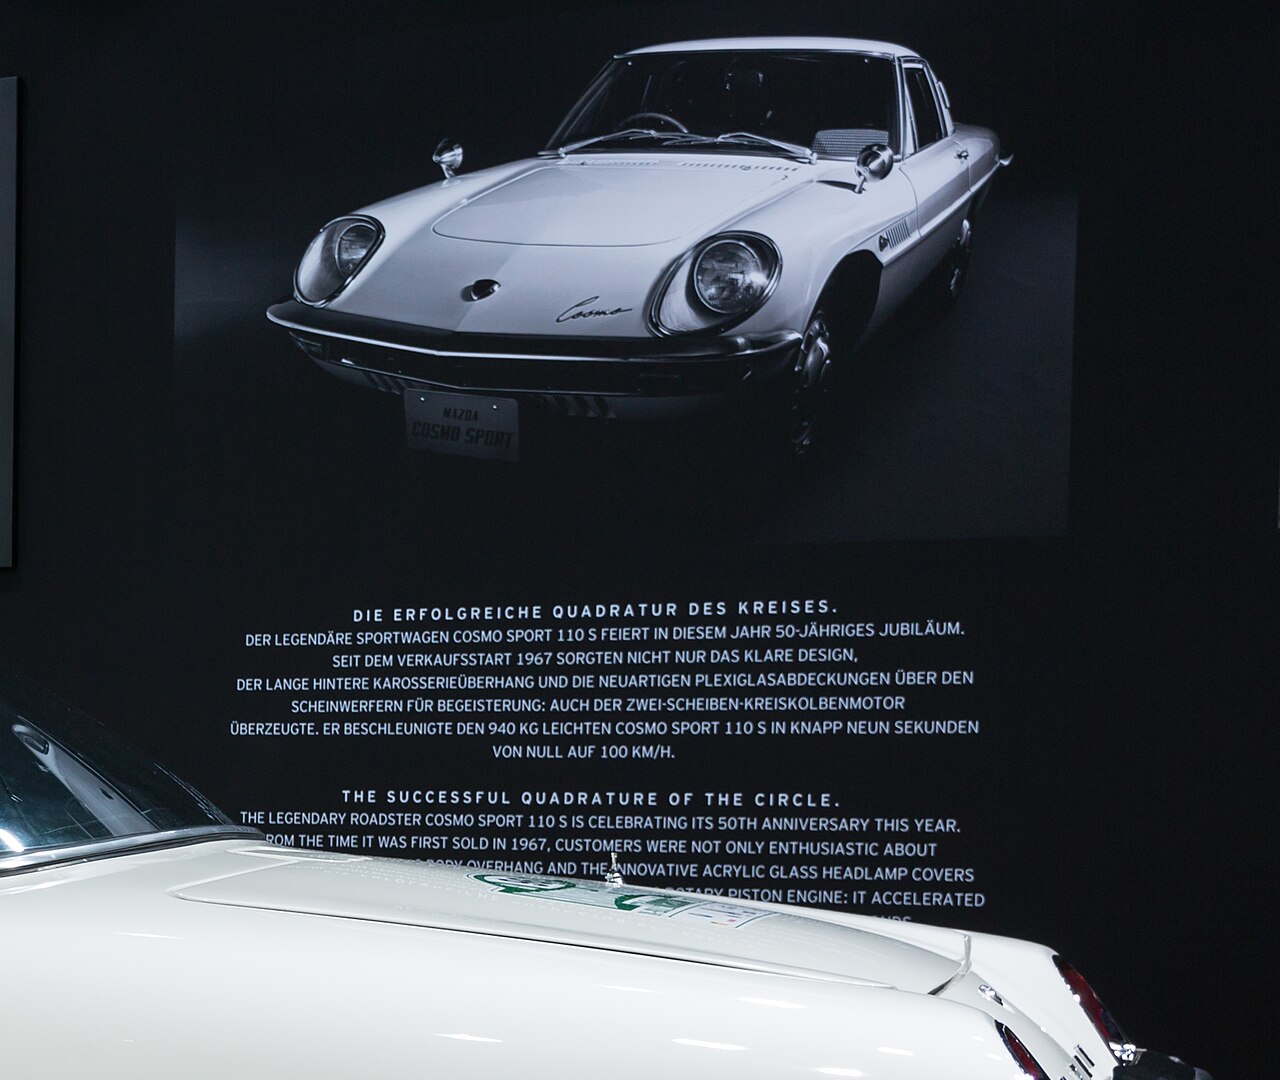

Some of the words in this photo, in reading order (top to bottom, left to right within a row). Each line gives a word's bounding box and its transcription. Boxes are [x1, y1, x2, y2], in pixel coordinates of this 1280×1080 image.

[411, 421, 462, 442] COSMO
[464, 427, 515, 449] SPORT
[353, 608, 383, 623] DIE
[393, 605, 542, 622] ERFOLGREICHE
[552, 602, 677, 619] QUADRATUR
[688, 601, 727, 616] DES
[738, 599, 837, 615] KREISES.
[245, 633, 272, 647] DER
[274, 630, 353, 647] LEGENDÄRE
[356, 630, 450, 645] SPORTWAGEN
[452, 629, 503, 644] COSMO
[506, 628, 553, 643] SPORT
[557, 628, 585, 642] 110
[601, 627, 650, 641] FEIERT
[654, 627, 669, 641] IN
[672, 625, 727, 640] DIESEM
[730, 625, 772, 640] JAHR
[775, 621, 875, 639] 50-JÄHRIGES
[878, 619, 965, 637] JUBILÄUM.
[332, 654, 362, 668] SEIT
[364, 654, 394, 668] DEM
[397, 652, 513, 667] VERKAUFSSTART
[517, 652, 553, 666] 1967
[556, 651, 624, 666] SORGTEN
[627, 650, 672, 665] NICHT
[675, 650, 707, 664] NUR
[710, 649, 741, 664] DAS
[744, 648, 794, 663] KLARE
[798, 647, 858, 663] DESIGN,
[236, 678, 263, 692] DER
[266, 677, 310, 691] LANGE
[313, 677, 370, 691] HINTERE
[373, 674, 535, 690] KAROSSERIEÜBERHANG
[538, 675, 569, 689] UND
[572, 674, 595, 689] DIE
[598, 674, 691, 689] NEUARTIGEN
[695, 671, 891, 688] PLEXIGLASABDECKUNGEN
[895, 669, 938, 686] ÜBER
[941, 670, 974, 685] DEN
[291, 699, 404, 714] SCHEINWERFERN
[406, 697, 434, 713] FÜR
[437, 698, 546, 713] BEGEISTERUNG:
[549, 698, 590, 712] AUCH
[593, 698, 623, 712] DER
[626, 696, 906, 712] ZWEI-SCHEIBEN-KREISKOLBENMOTOR
[230, 720, 320, 736] ÜBERZEUGTE.
[323, 722, 341, 736] ER
[344, 722, 453, 736] BESCHLEUNIGTE
[456, 722, 485, 736] DEN
[488, 721, 517, 736] 940
[519, 721, 540, 736] KG
[542, 721, 612, 736] LEICHTEN
[615, 721, 668, 736] COSMO
[671, 721, 720, 735] SPORT
[725, 721, 754, 735] 110
[771, 721, 787, 735] IN
[790, 720, 844, 735] KNAPP
[847, 720, 890, 735] NEUN
[894, 720, 980, 735] SEKUNDEN
[492, 744, 523, 759] VON
[526, 745, 564, 759] NULL
[567, 745, 597, 759] AUF
[601, 745, 629, 759] 100
[632, 744, 676, 760] KM/H.
[341, 789, 376, 804] THE
[386, 790, 511, 805] SUCCESSFUL
[521, 791, 657, 806] QUADRATURE
[668, 792, 694, 807] OF
[704, 792, 743, 807] THE
[754, 793, 840, 808] CIRCLE.
[240, 811, 265, 825] THE
[268, 811, 347, 825] LEGENDARY
[350, 812, 422, 827] ROADSTER
[425, 813, 475, 827] COSMO
[478, 814, 524, 828] SPORT
[528, 814, 556, 829] 110
[571, 815, 585, 829] IS
[588, 815, 688, 830] CELEBRATING
[691, 816, 714, 831] ITS
[718, 816, 758, 831] 50TH
[761, 817, 870, 832] ANNIVERSARY
[874, 818, 910, 833] THIS
[914, 818, 961, 833] YEAR.
[299, 834, 324, 847] THE
[328, 835, 358, 848] TIME
[362, 835, 374, 848] IT
[378, 836, 407, 849] WAS
[411, 836, 448, 849] FIRST
[452, 837, 489, 850] SOLD
[493, 837, 506, 850] IN
[511, 837, 551, 852] 1967,
[554, 838, 642, 853] CUSTOMERS
[646, 839, 687, 854] WERE
[691, 840, 722, 854] NOT
[725, 840, 765, 855] ONLY
[769, 840, 879, 857] ENTHUSIASTIC
[883, 842, 938, 857] ABOUT
[548, 862, 577, 876] AND
[581, 862, 608, 876] THE
[702, 864, 766, 879] ACRYLIC
[769, 864, 819, 880] GLASS
[822, 866, 909, 881] HEADLAMP
[911, 867, 975, 883] COVERS
[787, 889, 848, 905] ENGINE:
[853, 890, 867, 905] IT
[871, 891, 986, 908] ACCELERATED
